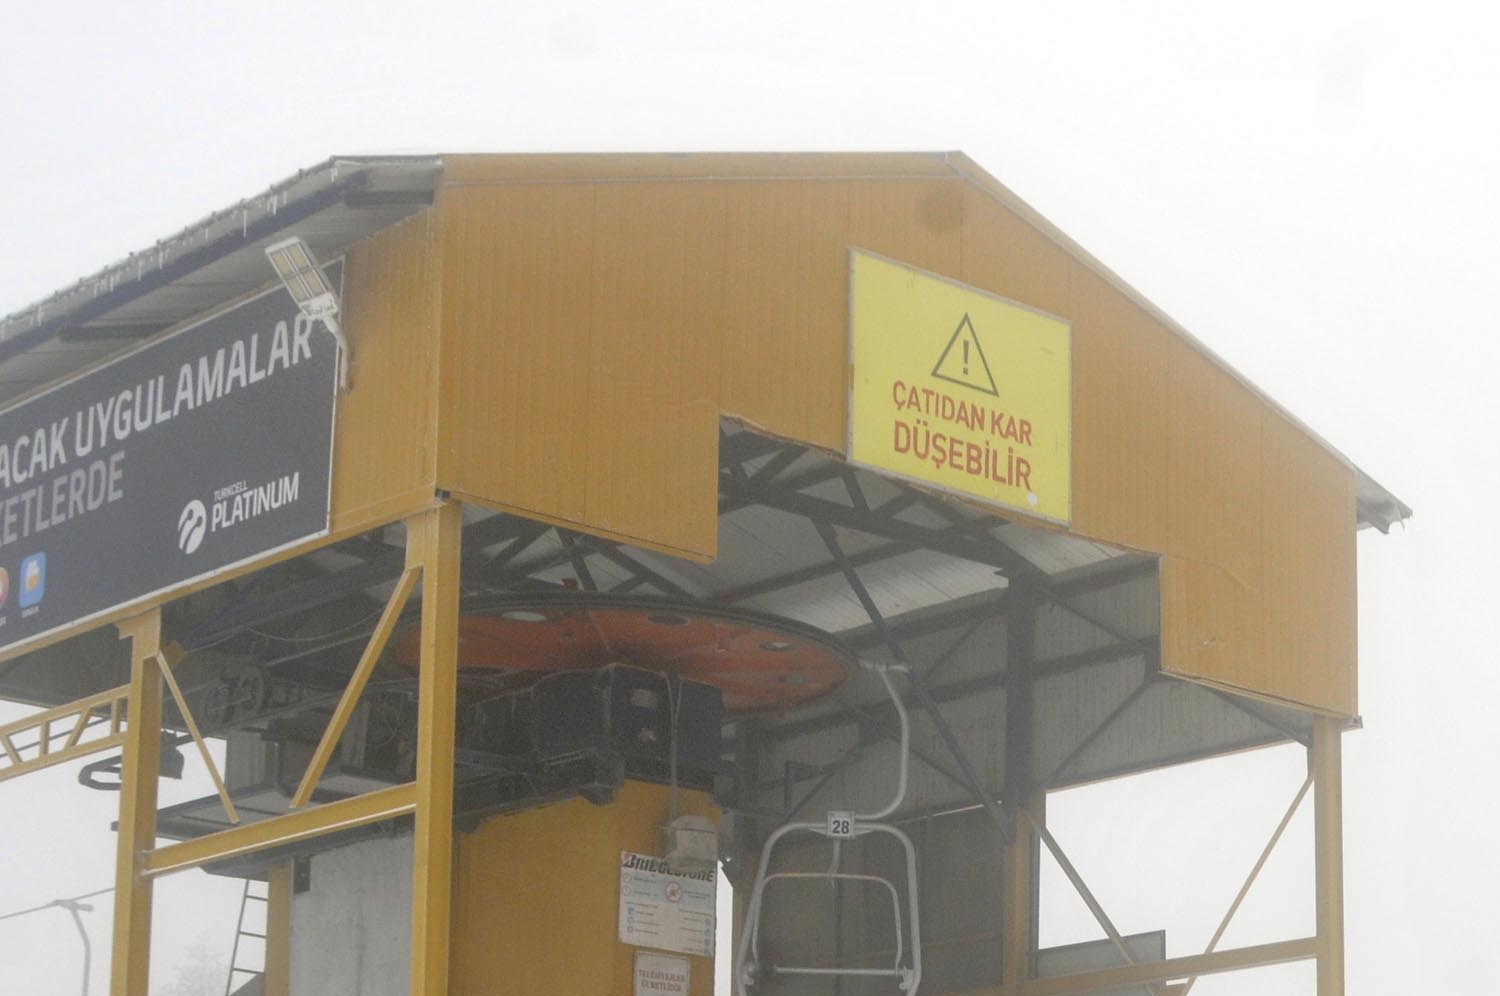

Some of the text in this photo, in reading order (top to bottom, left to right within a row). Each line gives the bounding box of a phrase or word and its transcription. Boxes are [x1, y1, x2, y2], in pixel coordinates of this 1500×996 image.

[0, 312, 313, 488] ACAK UYGULAMALAR
[892, 380, 1032, 446] ÇATIDAN KAR
[893, 418, 1032, 490] DÜŞEBİLİR
[0, 451, 125, 545] ETLERDE
[211, 471, 299, 532] PLATINUM
[832, 820, 850, 834] 28
